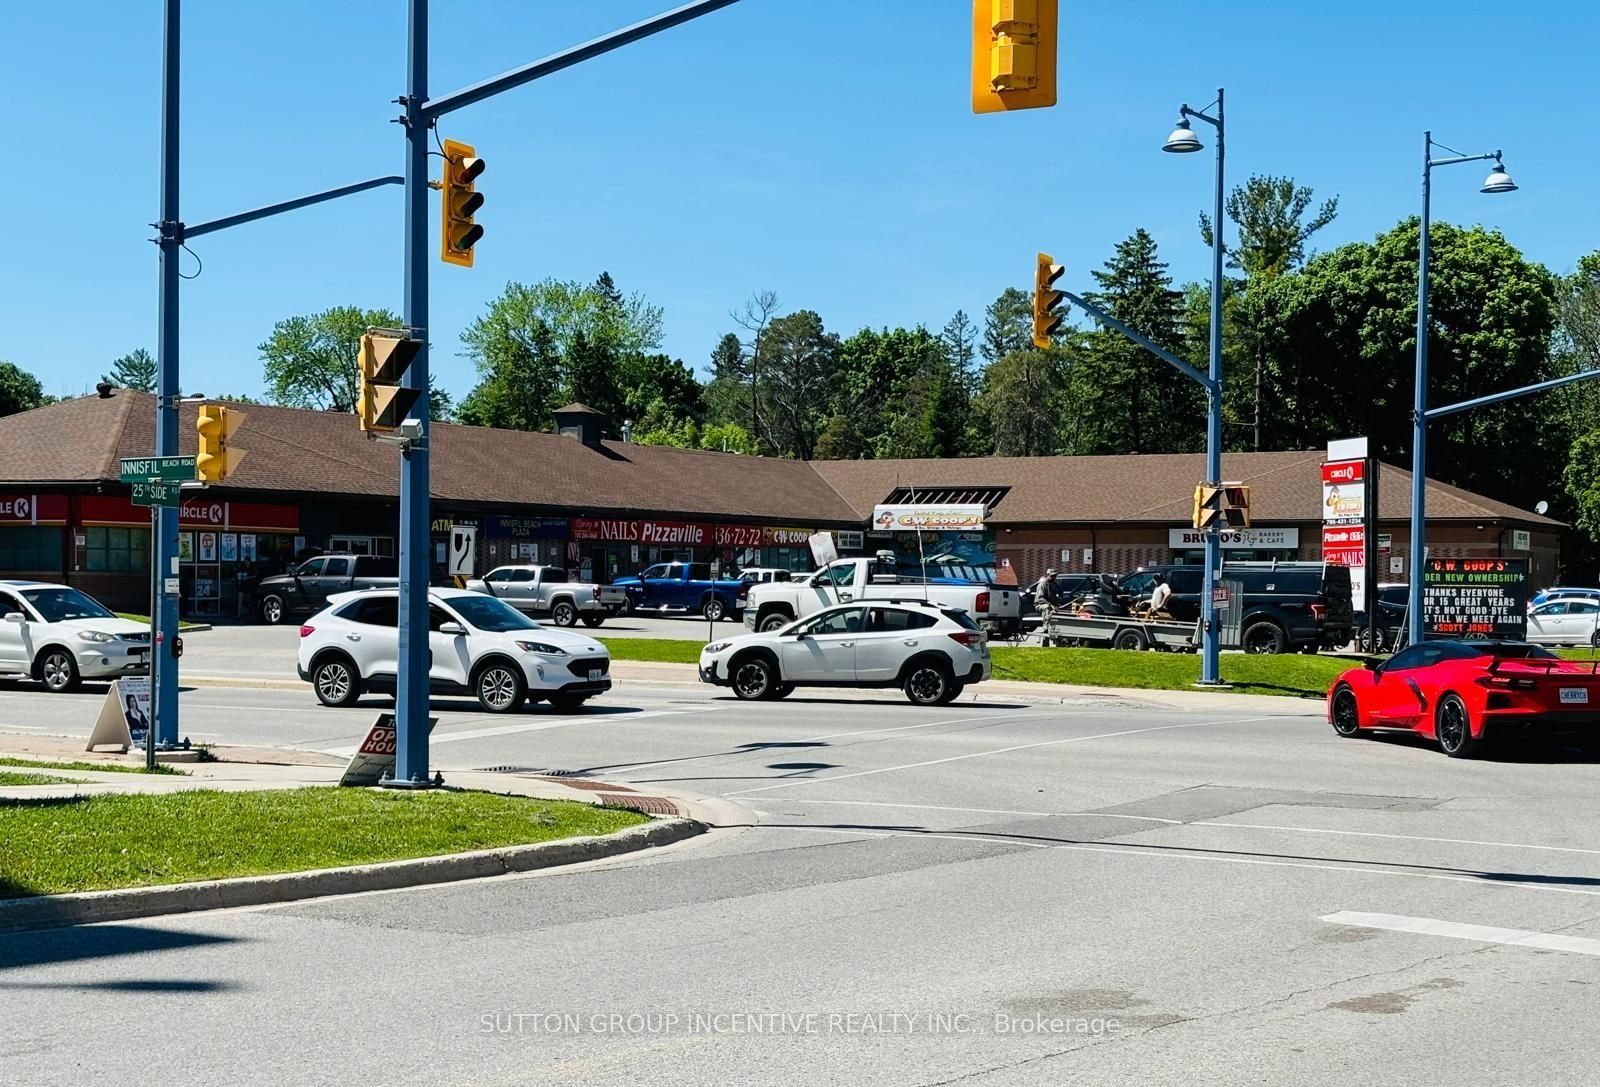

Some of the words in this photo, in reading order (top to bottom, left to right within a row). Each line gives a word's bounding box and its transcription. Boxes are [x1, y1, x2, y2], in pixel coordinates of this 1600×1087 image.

[121, 461, 160, 475] INNISFIL
[181, 458, 195, 466] ROAD
[1330, 469, 1347, 478] CIRCLE
[150, 486, 167, 500] SIDE
[14, 497, 29, 518] K
[179, 507, 208, 518] IRCLE
[209, 504, 223, 523] K
[431, 519, 454, 532] ATM
[523, 520, 542, 529] BEACH
[511, 527, 531, 537] PLAZA
[600, 520, 638, 541] NAILS
[641, 522, 704, 543] Pizzaville
[1183, 533, 1241, 543] BRUO'S
[1341, 551, 1363, 566] NAILS
[1445, 573, 1465, 582] NEW
[1468, 573, 1519, 582] OWNERSHIP
[1424, 588, 1457, 597] THANKS
[1460, 588, 1504, 597] EVERYONE
[1439, 597, 1449, 606] 15
[1454, 598, 1482, 607] GREAT
[1488, 598, 1515, 607] YEARS
[1444, 606, 1461, 614] NOT
[1433, 615, 1452, 623] TILL
[1455, 615, 1469, 623] WE
[1471, 615, 1494, 624] MEET
[1497, 615, 1522, 624] AGAIN
[1438, 623, 1463, 632] SCOTT
[1466, 624, 1493, 632] JONES
[372, 729, 396, 741] OP
[364, 741, 396, 752] HOU
